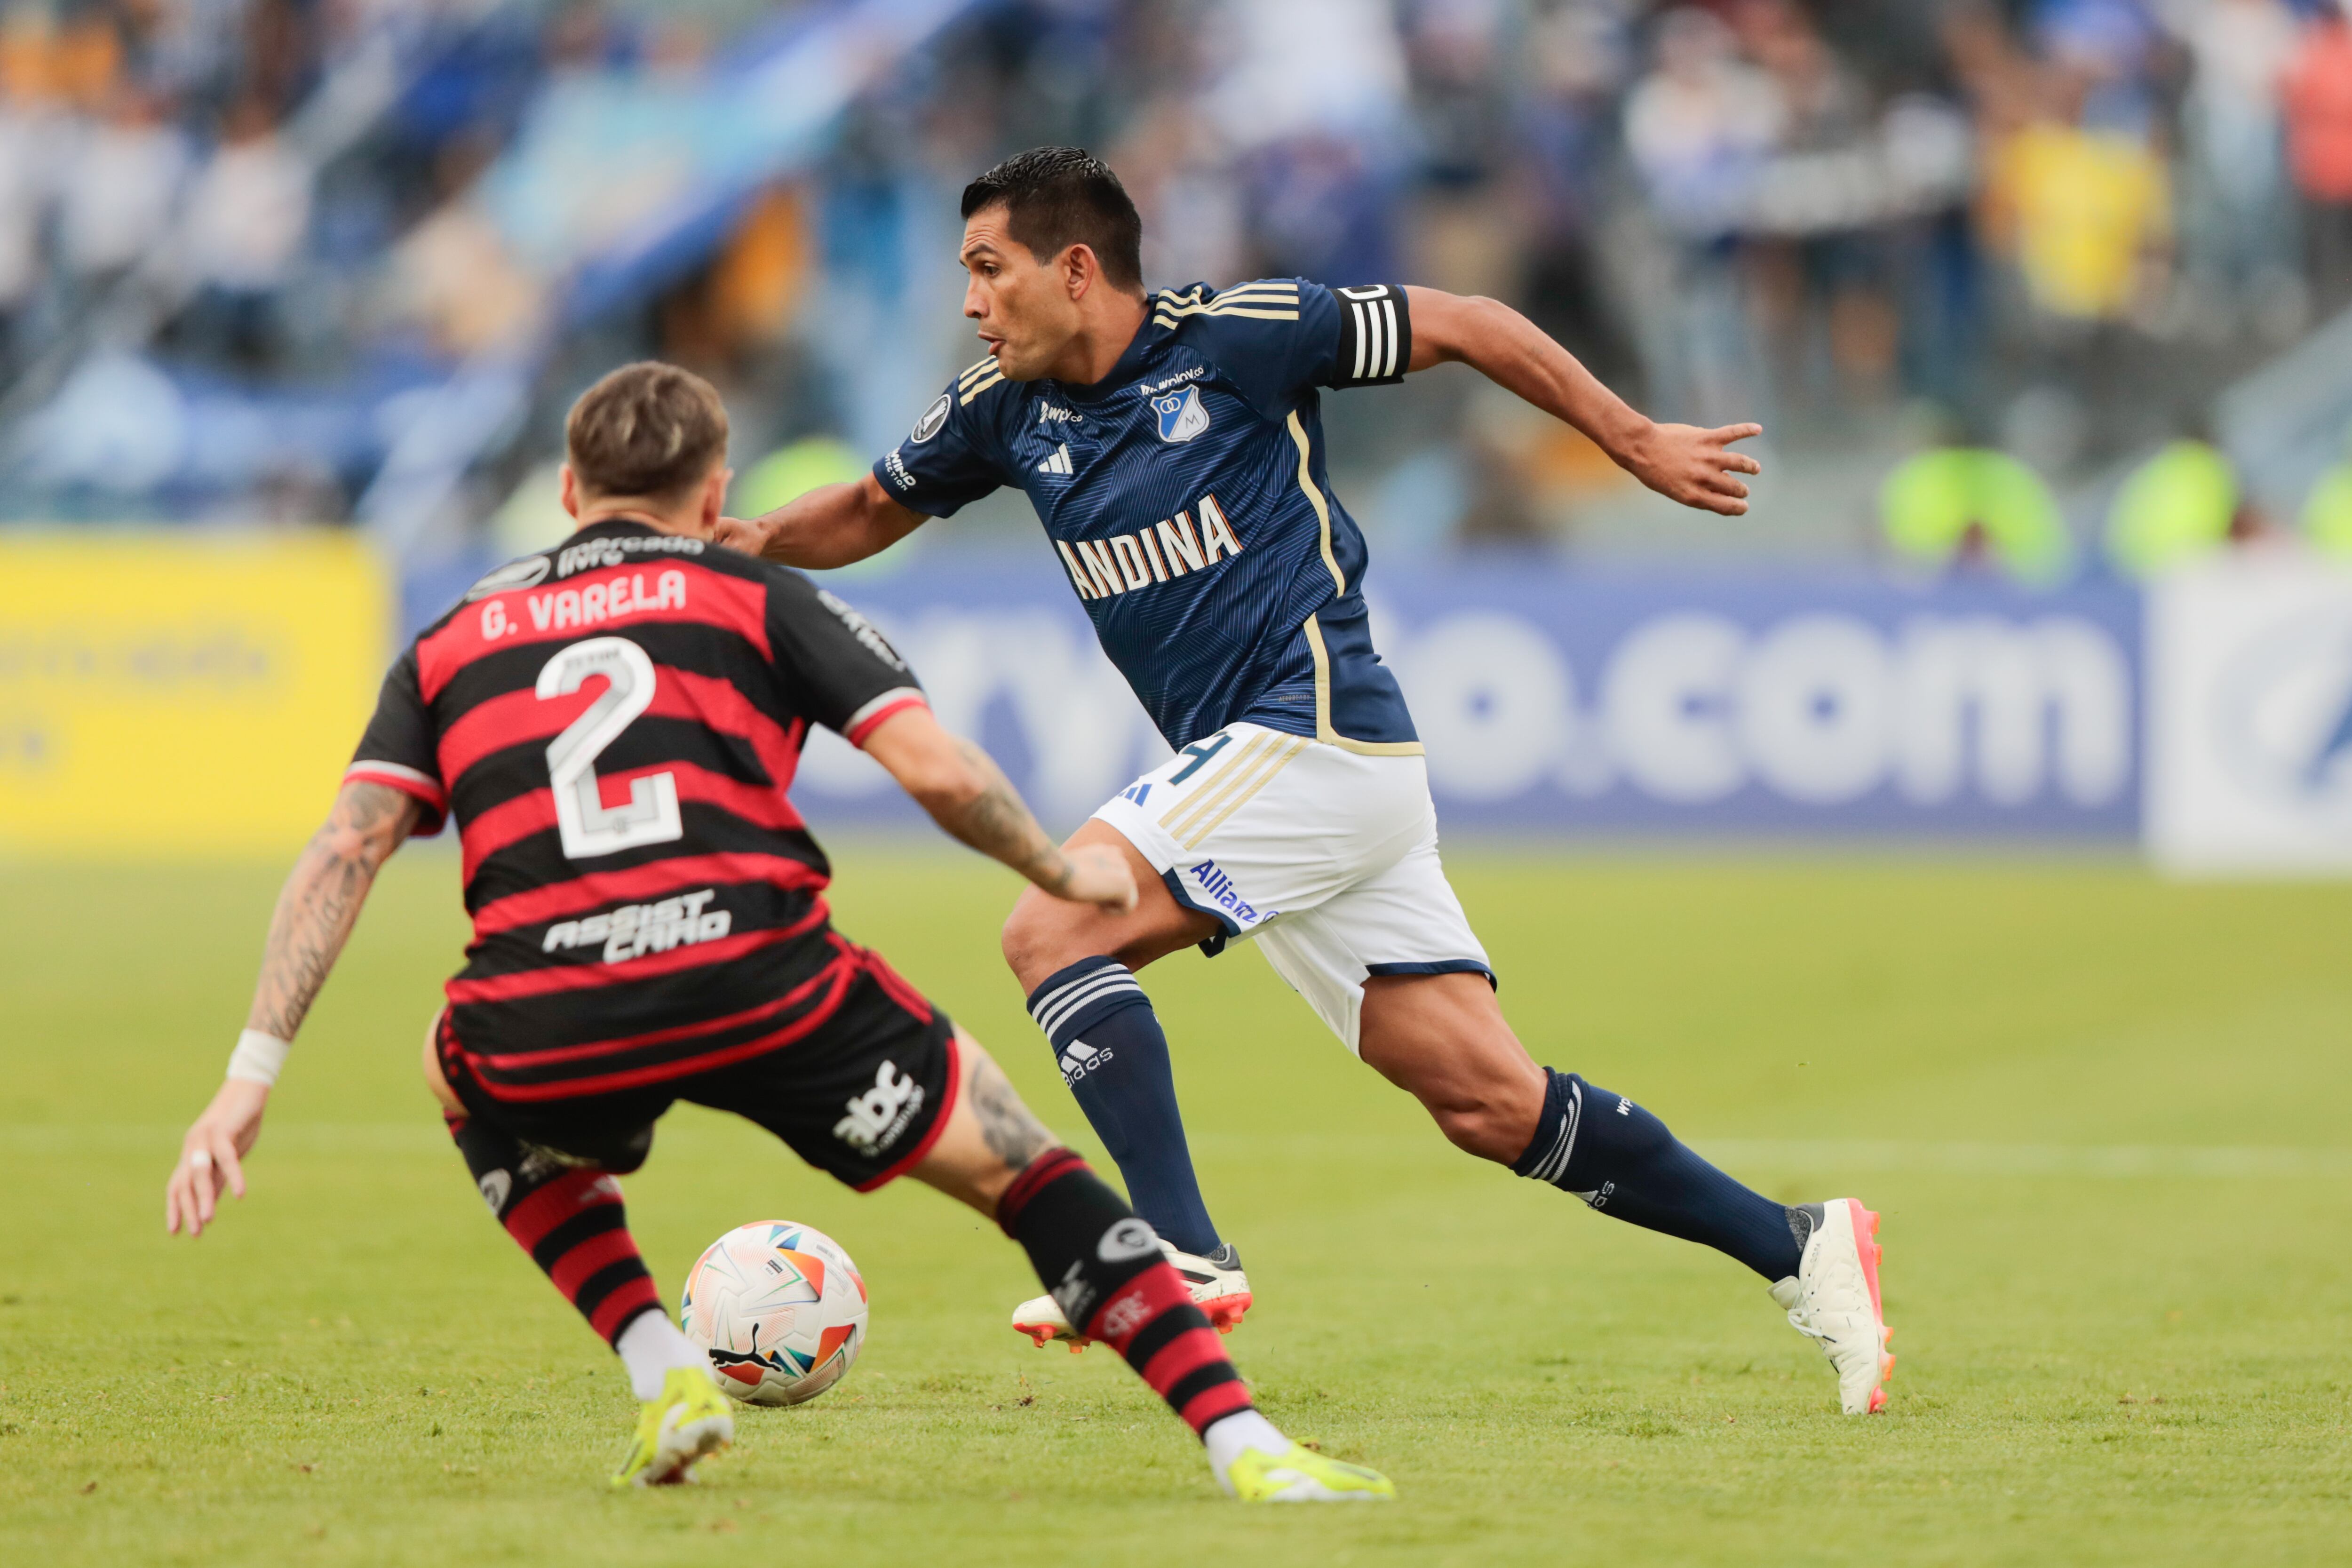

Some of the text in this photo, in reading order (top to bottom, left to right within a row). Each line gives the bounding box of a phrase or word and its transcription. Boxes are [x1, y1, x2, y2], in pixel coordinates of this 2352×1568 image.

[1056, 493, 1243, 600] ANDINA
[481, 570, 686, 640] G. VARELA
[535, 636, 683, 859] 2
[541, 888, 715, 954] ASSIST
